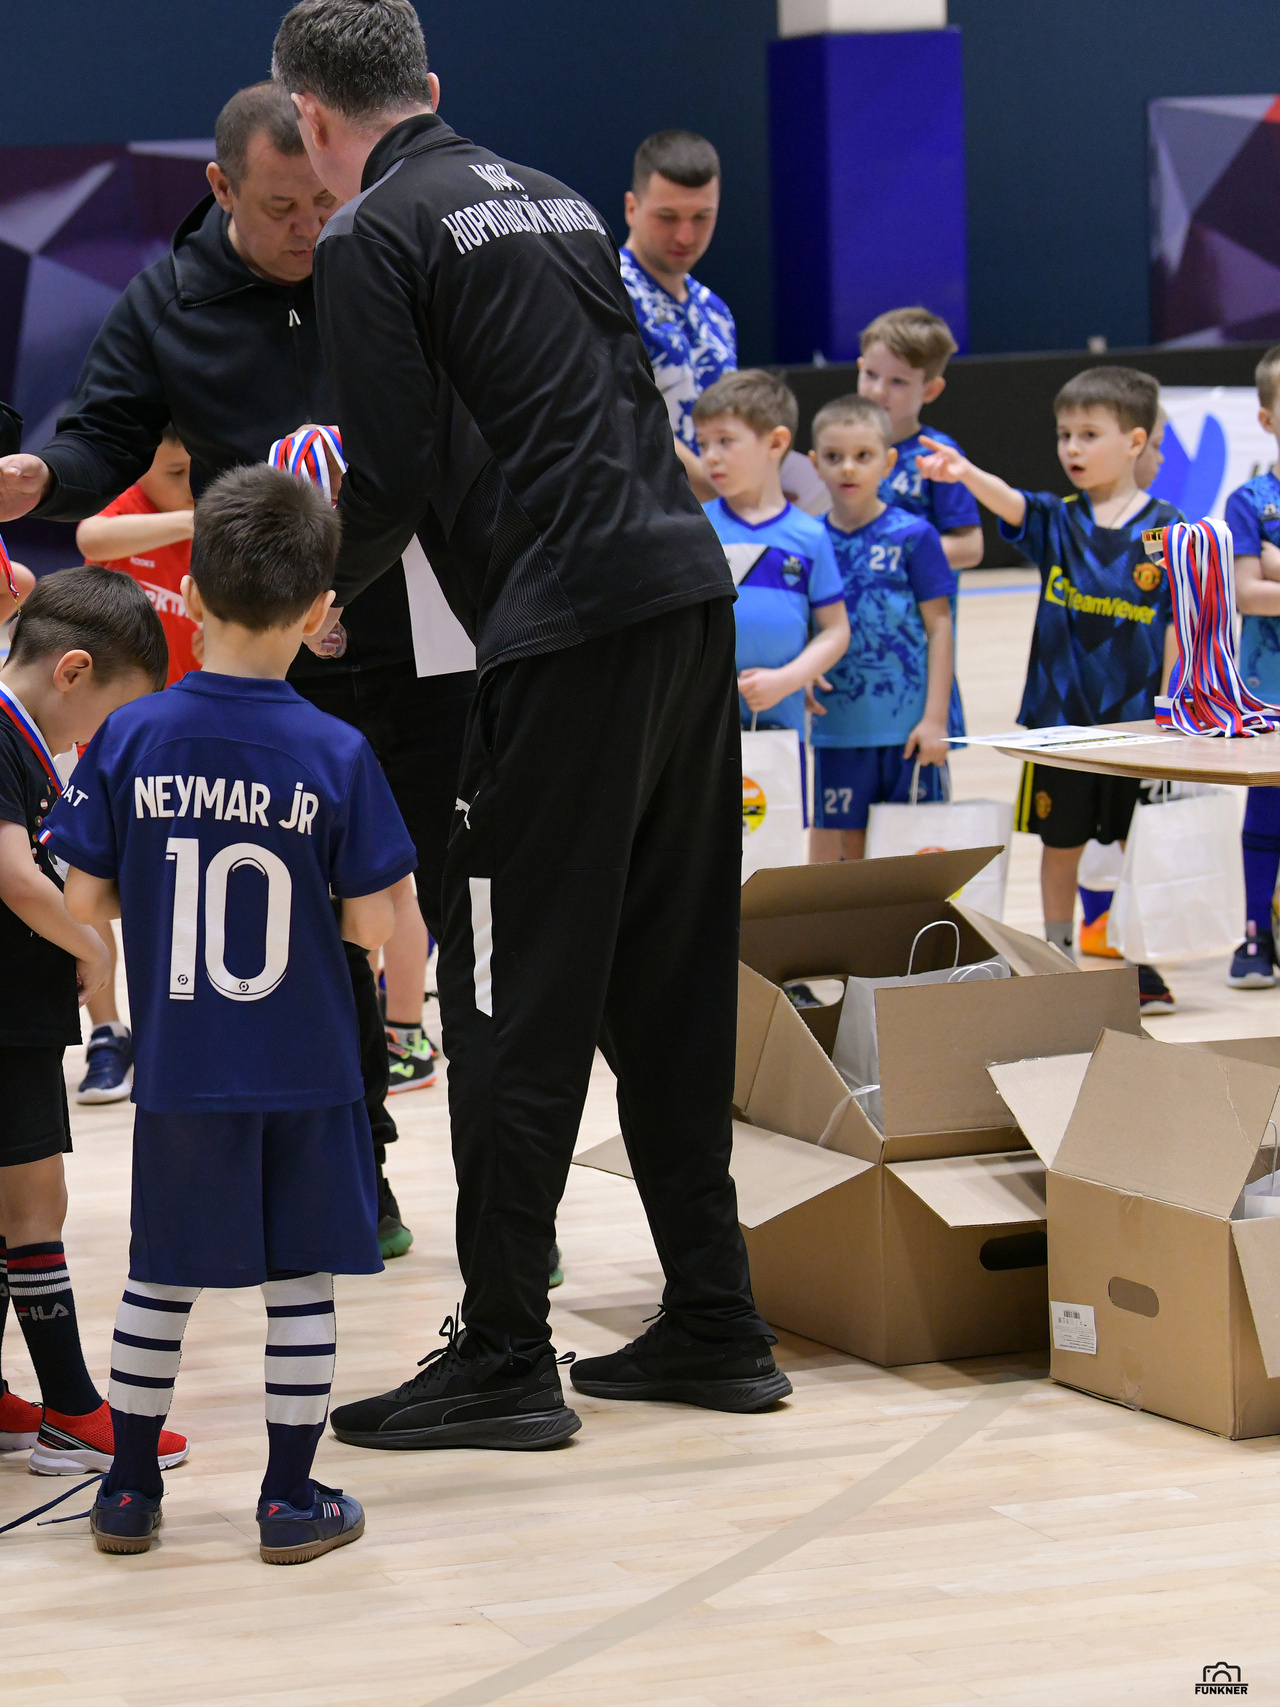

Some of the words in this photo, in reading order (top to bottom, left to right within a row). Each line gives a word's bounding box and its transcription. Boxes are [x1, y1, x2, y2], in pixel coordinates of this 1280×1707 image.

[468, 163, 526, 191] МФК
[869, 544, 902, 572] 27
[1067, 586, 1157, 625] TeamViewer
[60, 780, 89, 808] AT
[134, 774, 272, 827] NEYMAR
[823, 787, 853, 815] 27
[165, 836, 293, 1002] 10
[16, 1301, 70, 1321] FILA
